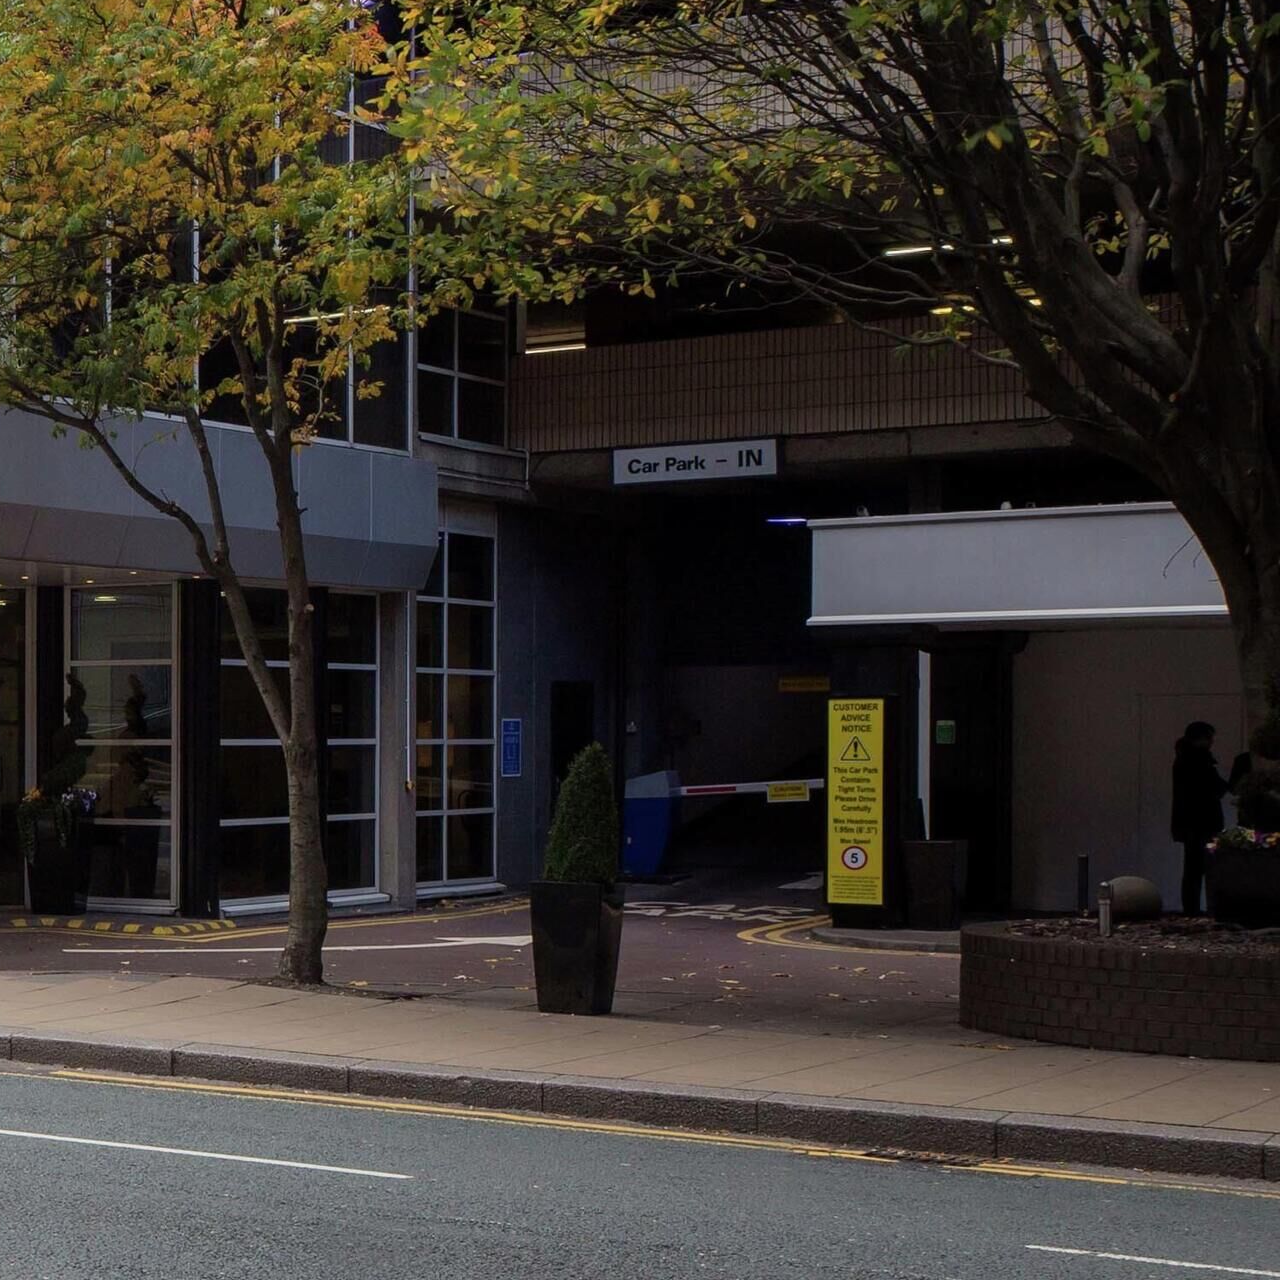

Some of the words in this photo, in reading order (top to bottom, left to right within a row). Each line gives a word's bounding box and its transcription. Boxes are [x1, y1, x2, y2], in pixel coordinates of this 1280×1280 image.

[627, 458, 660, 475] Car
[665, 455, 707, 473] Park
[738, 448, 763, 468] IN
[833, 703, 879, 712] CUSTOMER
[840, 714, 871, 722] ADVICE
[841, 724, 873, 733] NOTICE
[833, 766, 848, 774] This
[849, 766, 861, 774] Car
[862, 766, 879, 774] Park
[850, 852, 859, 864] 5
